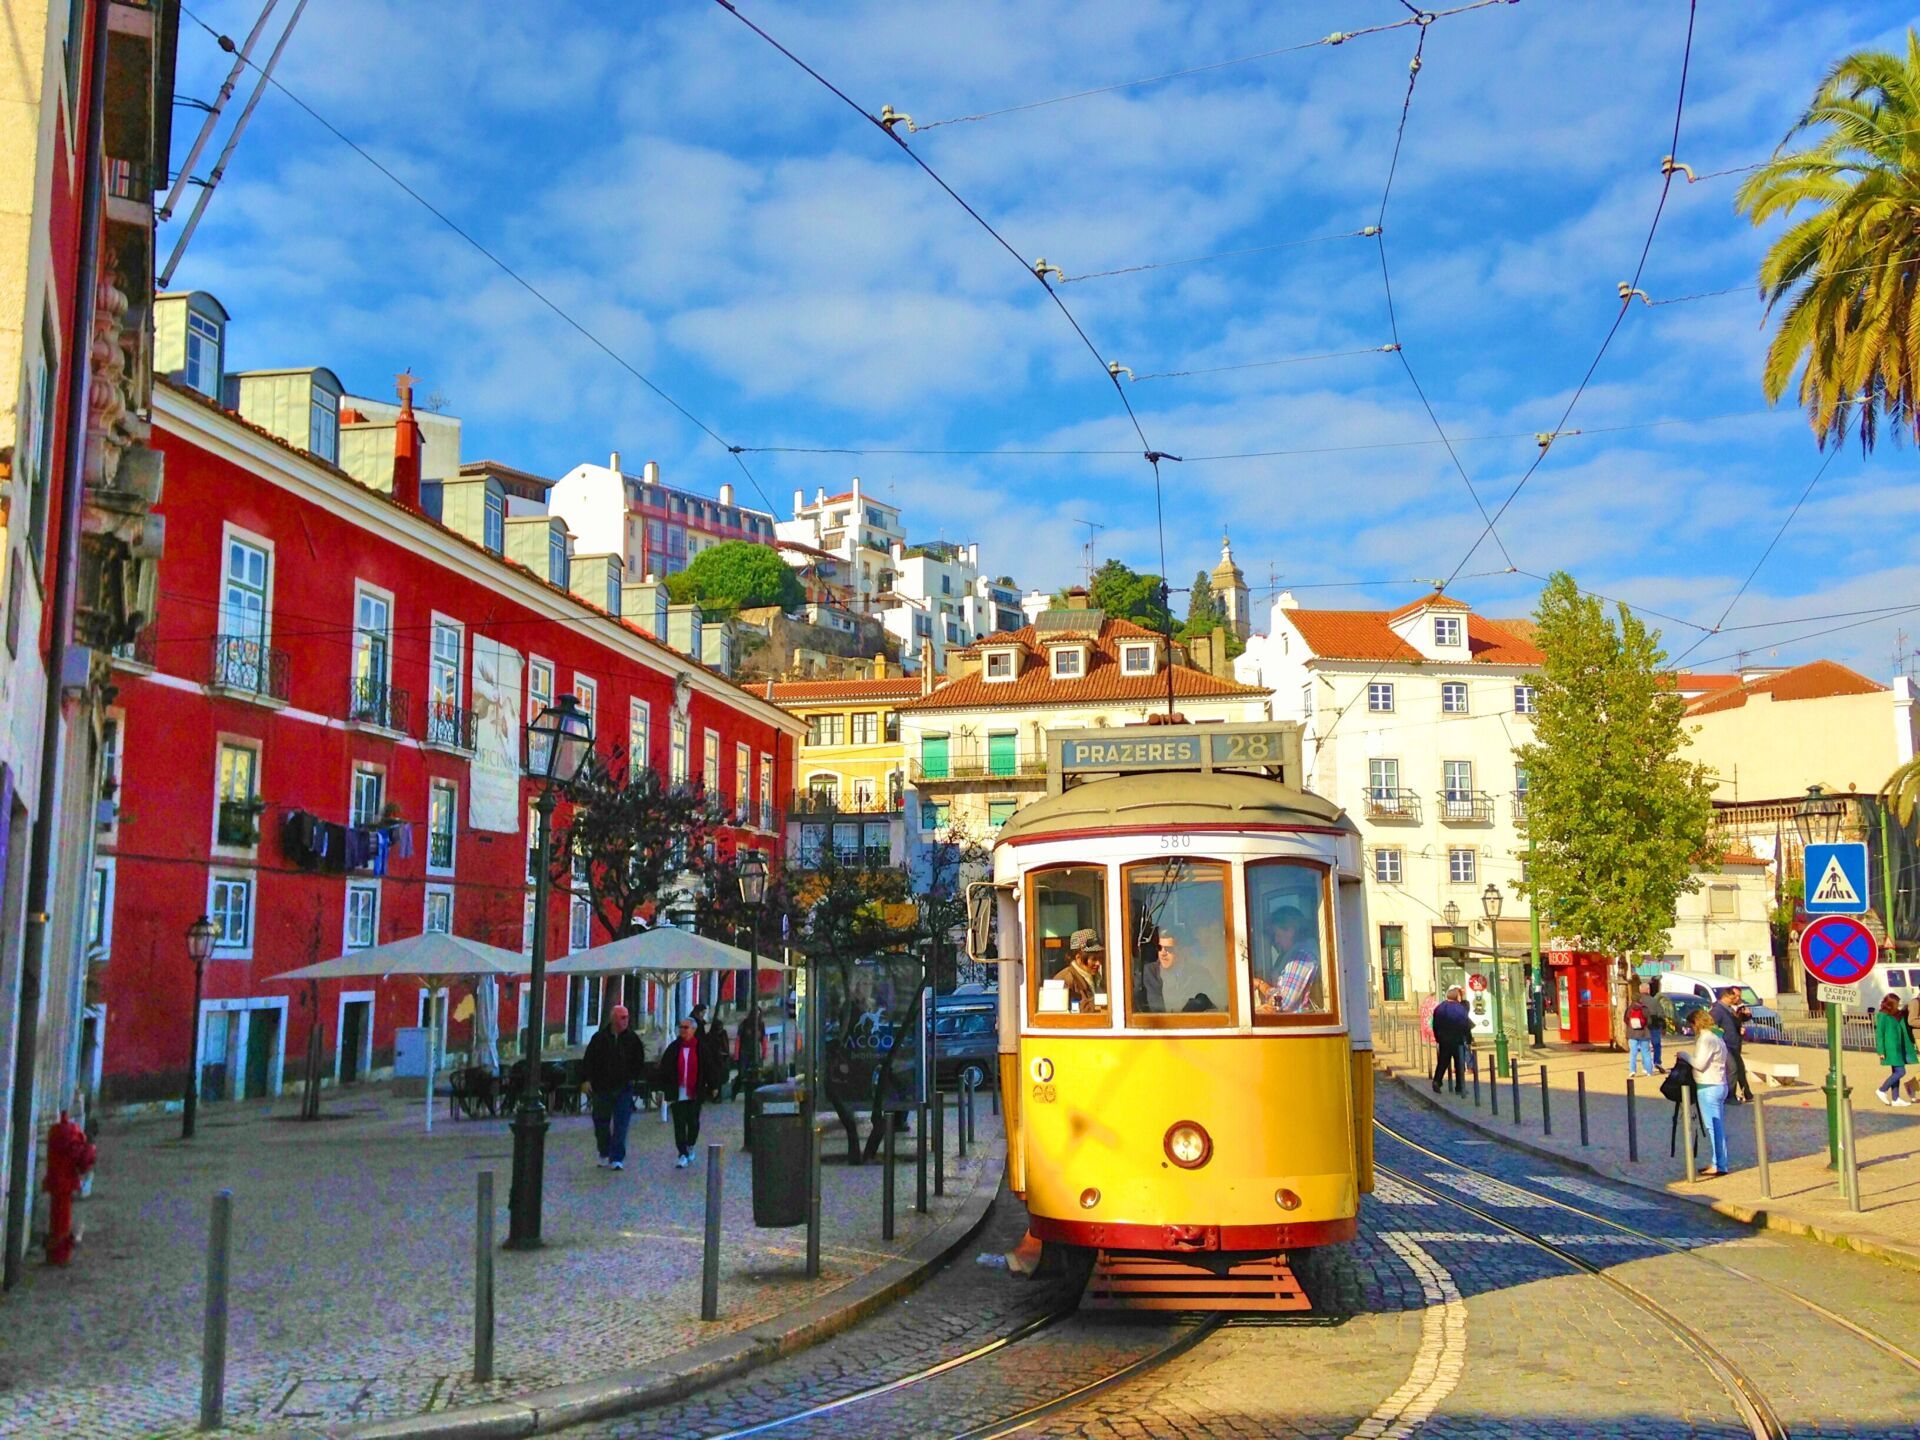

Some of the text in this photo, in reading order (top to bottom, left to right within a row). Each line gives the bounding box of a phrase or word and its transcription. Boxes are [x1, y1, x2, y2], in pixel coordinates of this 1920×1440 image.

[1075, 742, 1192, 763] PRAZERES
[1226, 733, 1269, 761] 28
[1160, 834, 1191, 849] 580
[1824, 987, 1856, 997] EXCEPTO
[1825, 993, 1854, 1002] CARRIS
